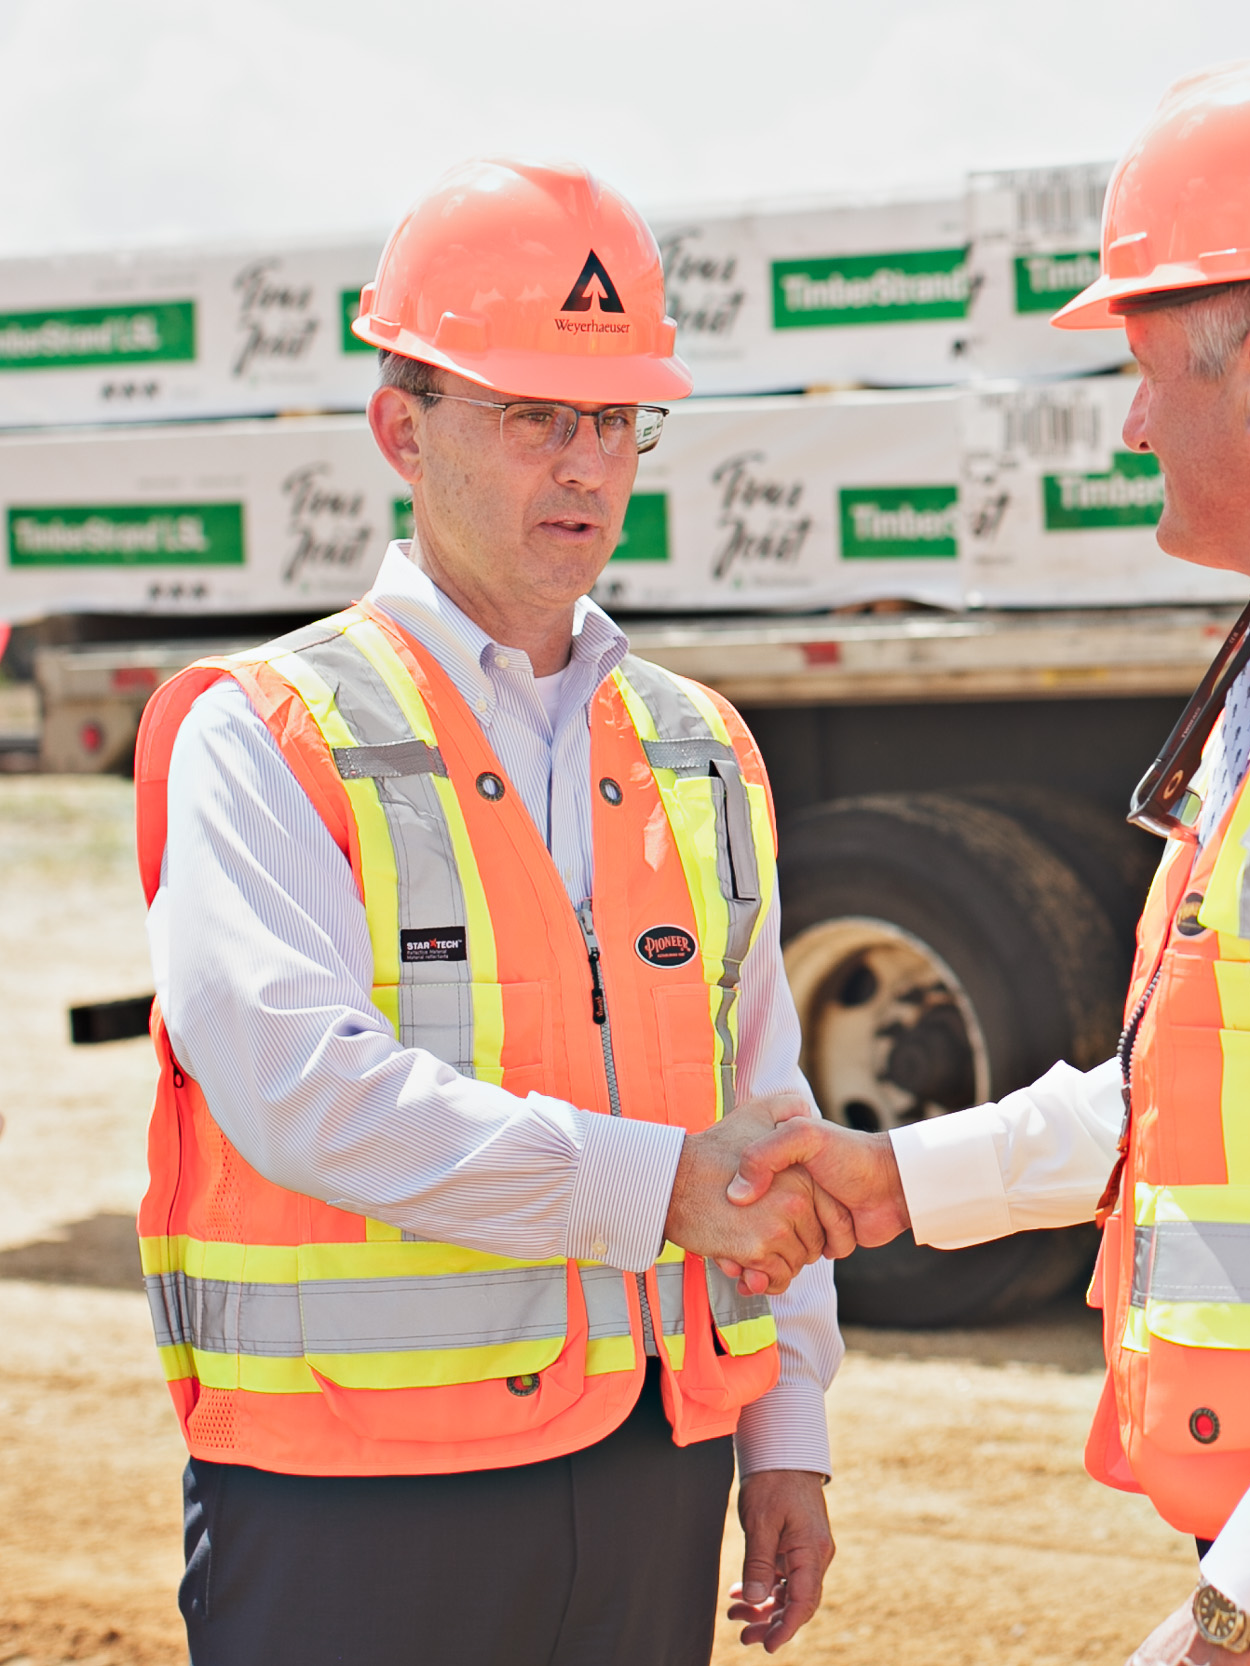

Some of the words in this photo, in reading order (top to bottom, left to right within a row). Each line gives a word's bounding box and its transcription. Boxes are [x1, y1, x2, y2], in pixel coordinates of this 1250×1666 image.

[554, 319, 630, 335] Weyerhaeuser
[407, 942, 430, 950] STAR
[644, 935, 692, 959] PIONEER
